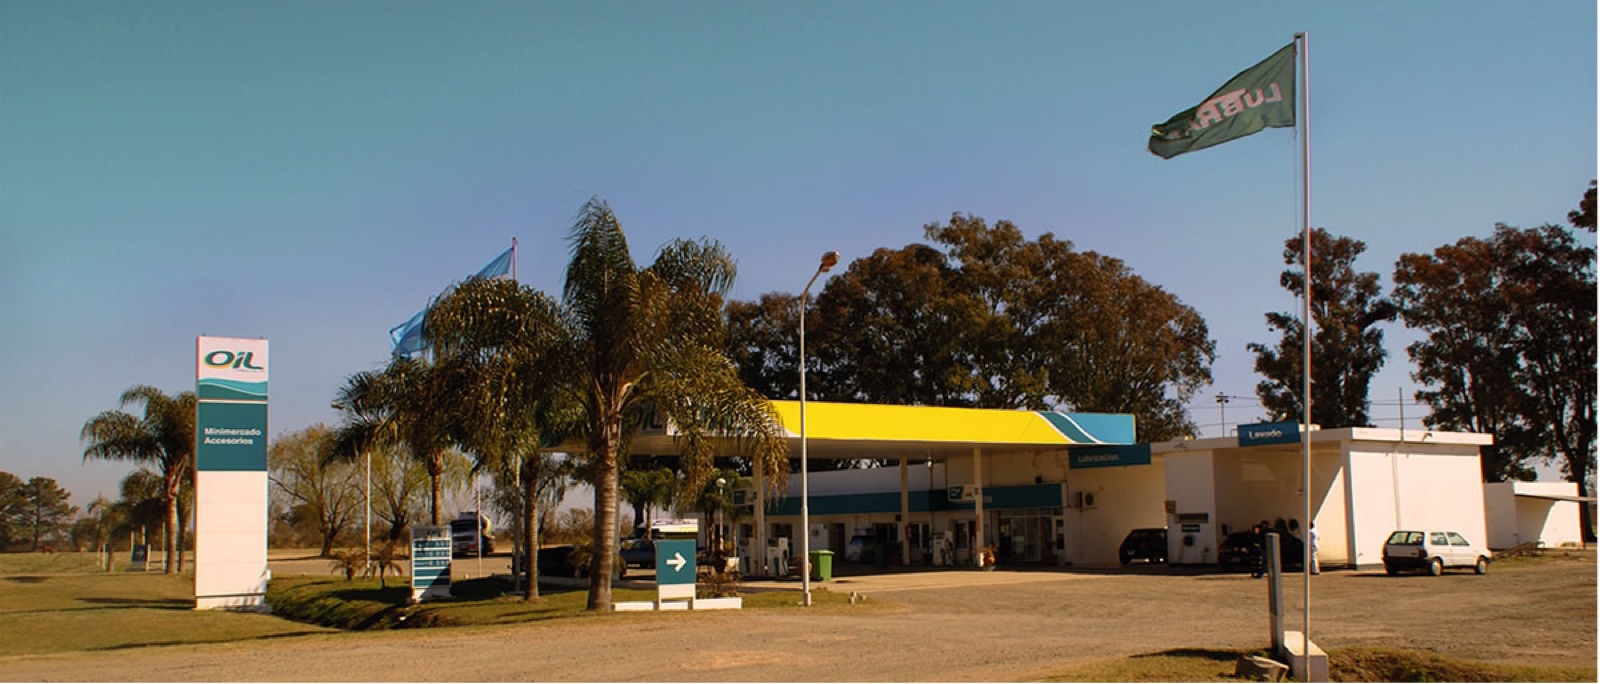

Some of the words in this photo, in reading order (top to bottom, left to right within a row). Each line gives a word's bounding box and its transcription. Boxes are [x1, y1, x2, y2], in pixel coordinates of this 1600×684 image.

[204, 428, 261, 436] Minimercado
[1248, 429, 1282, 440] Lavado
[204, 437, 253, 445] Accesorios
